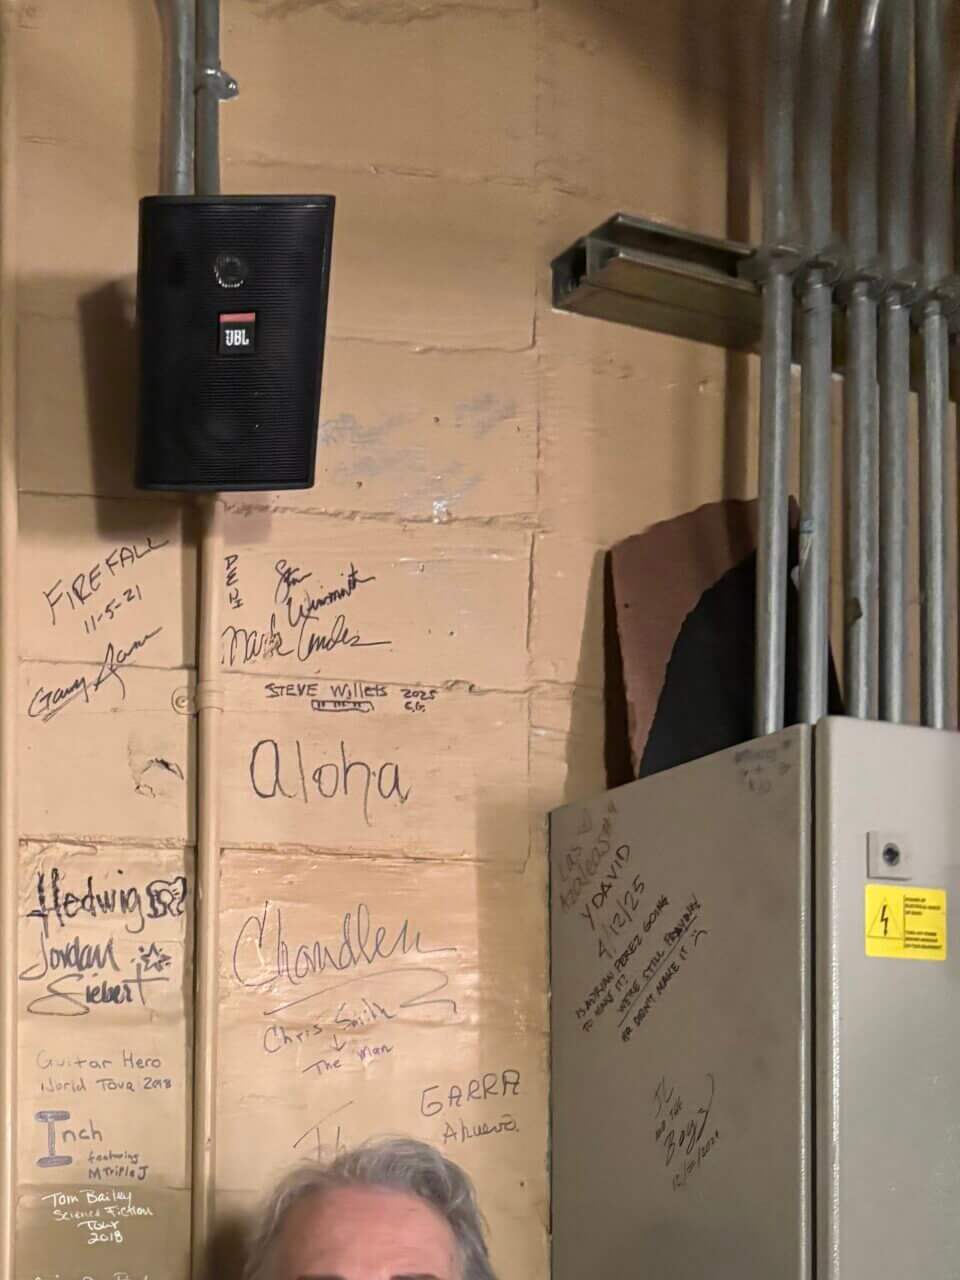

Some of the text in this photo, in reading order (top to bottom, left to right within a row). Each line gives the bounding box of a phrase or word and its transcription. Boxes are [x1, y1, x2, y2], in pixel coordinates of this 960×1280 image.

[224, 329, 250, 346] JBL
[43, 537, 170, 625] FIREFALL
[265, 683, 319, 698] STEVE
[41, 1191, 79, 1208] Tom
